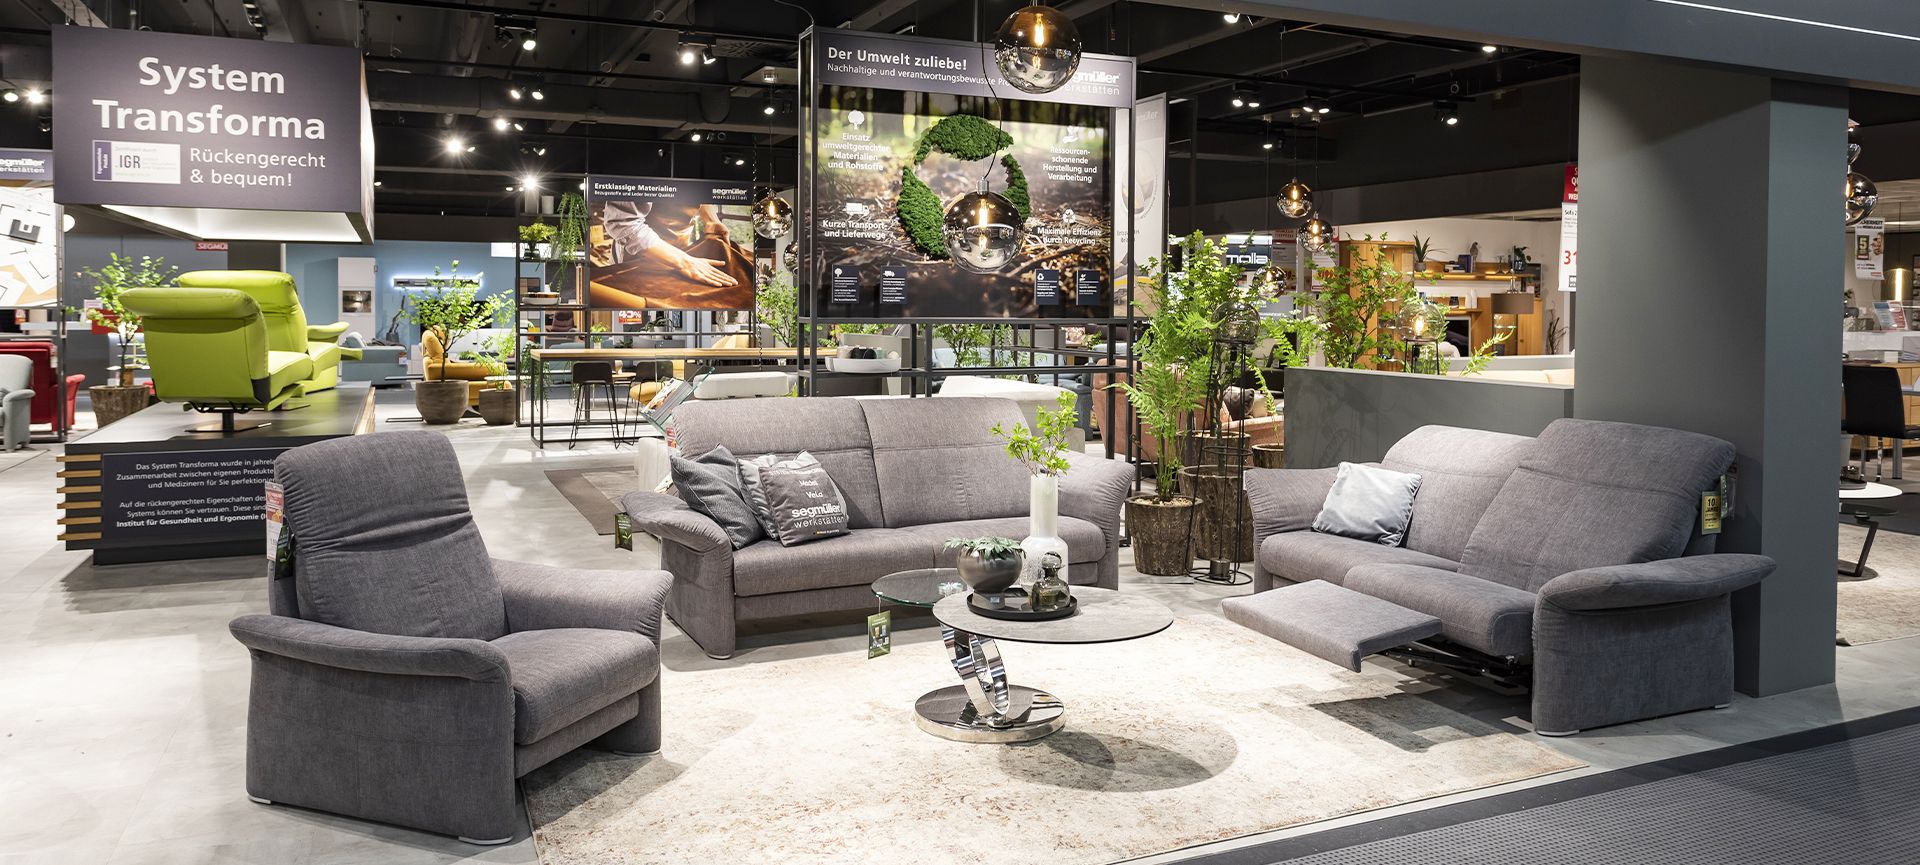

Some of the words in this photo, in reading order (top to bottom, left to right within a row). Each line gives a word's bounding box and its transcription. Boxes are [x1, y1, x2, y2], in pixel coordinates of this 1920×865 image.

[828, 47, 852, 60] Der
[857, 50, 910, 65] Umwelt
[914, 56, 967, 70] zuliebe!
[827, 63, 877, 76] Nachhaltige
[880, 68, 896, 76] und
[138, 56, 284, 95] System
[92, 99, 325, 140] Transforma
[842, 132, 870, 142] Einsatz
[120, 154, 141, 168] IGR
[190, 148, 326, 168] Rückengerecht
[834, 152, 878, 160] Materialien
[1052, 156, 1088, 164] schonende
[846, 162, 884, 170] Rohstoffe
[1042, 164, 1082, 174] Herstellung
[190, 170, 204, 184] &
[212, 170, 292, 188] bequem!
[1048, 172, 1092, 183] Verarbeitung
[594, 182, 636, 191] Erstklassige
[638, 184, 677, 192] Materialien
[822, 220, 846, 228] Kurze
[848, 220, 888, 230] Transport-
[842, 230, 886, 240] Lieferwege
[1037, 227, 1070, 235] Maximale
[1072, 228, 1101, 236] Effizienz
[1860, 237, 1868, 248] 5
[152, 462, 177, 470] System
[179, 461, 218, 469] Transforma
[116, 472, 177, 480] Zusammenarbeit
[214, 470, 241, 478] eigenen
[148, 499, 205, 507] rückengerechten
[206, 496, 253, 505] Eigenschaften
[127, 510, 155, 518] Systems
[792, 503, 840, 518] segmüller
[159, 517, 202, 525] Gesundheit
[220, 514, 259, 523] Ergonomie
